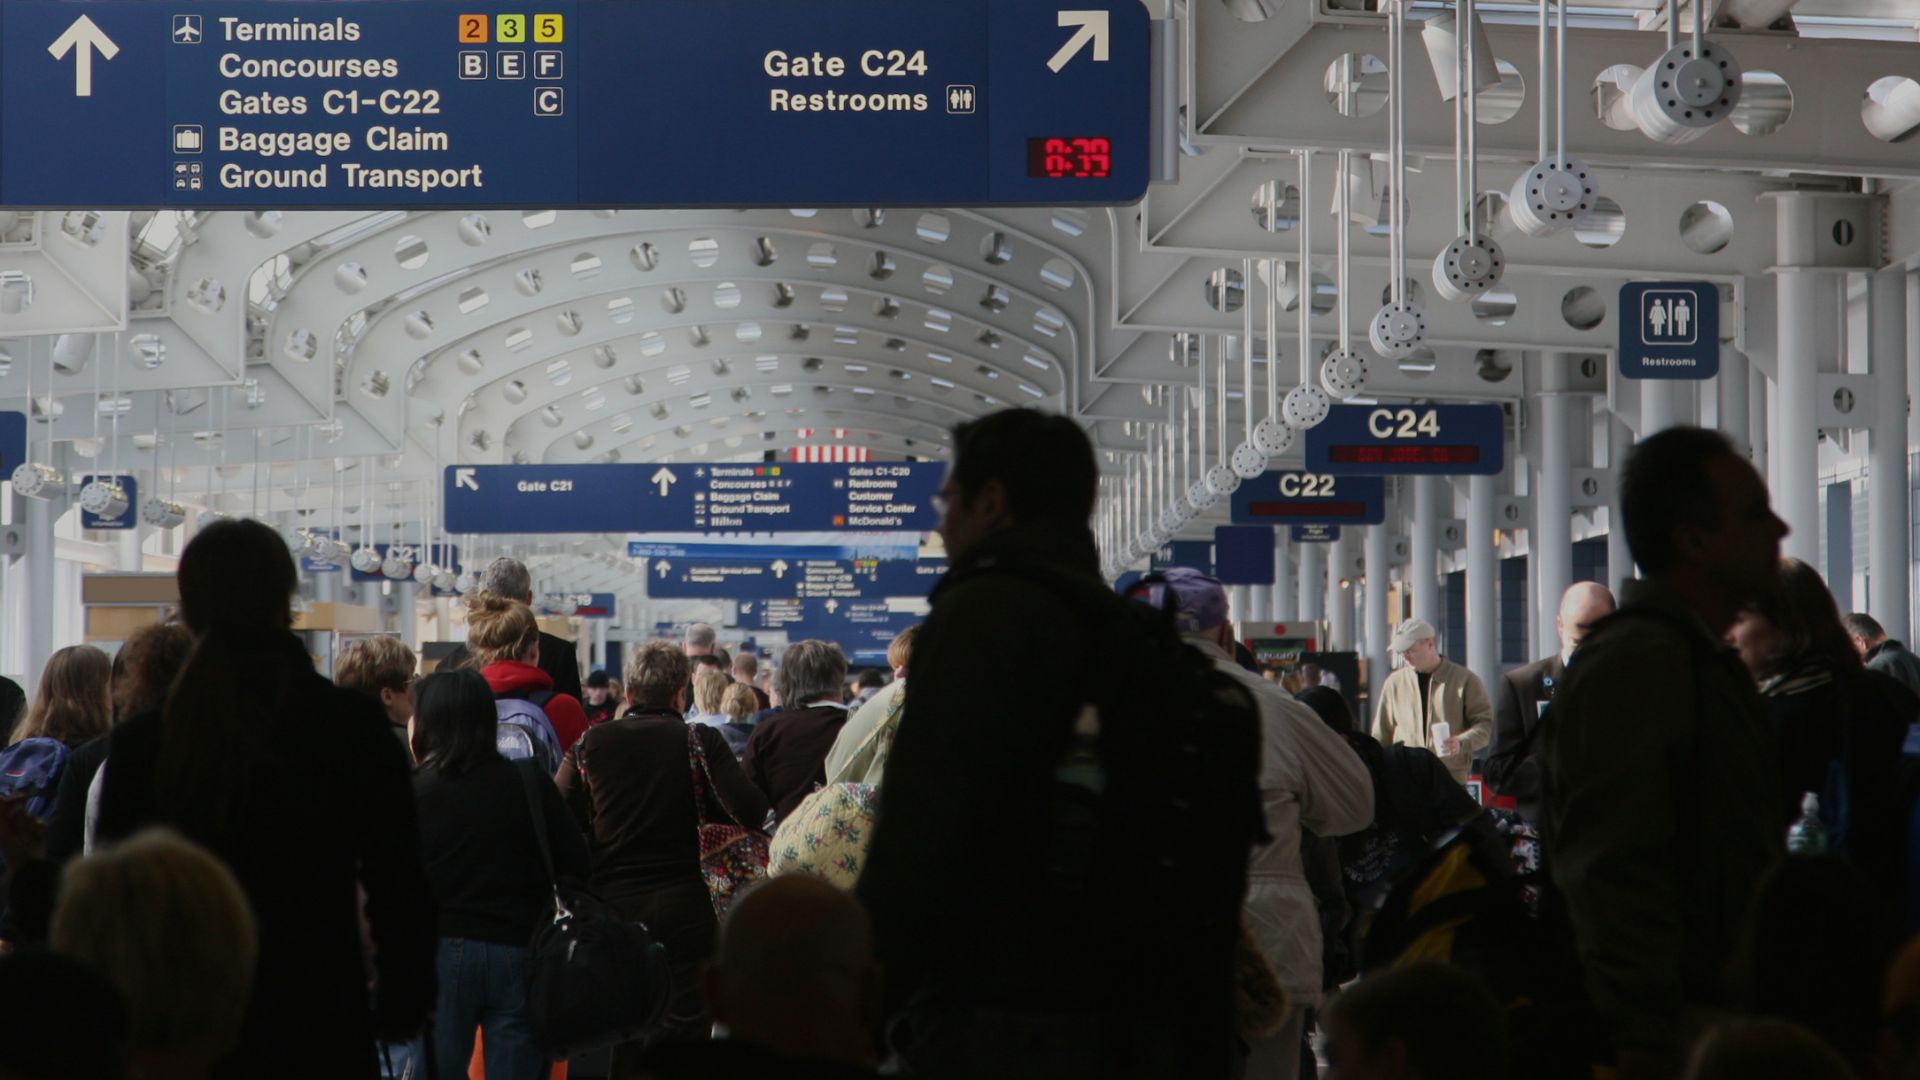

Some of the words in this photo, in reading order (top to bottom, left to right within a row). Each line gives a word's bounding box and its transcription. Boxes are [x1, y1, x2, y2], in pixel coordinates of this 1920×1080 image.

[219, 17, 360, 41] Terminals
[467, 19, 480, 37] 2
[504, 19, 517, 37] 3
[542, 19, 555, 37] 5
[220, 53, 398, 78] Concourses
[465, 55, 481, 75] B
[504, 55, 518, 75] E
[541, 55, 555, 74] F
[764, 51, 844, 77] Gate
[861, 50, 927, 76] C24
[220, 90, 307, 114] Gates
[323, 90, 439, 114] C1-C22
[540, 91, 557, 112] C
[771, 89, 927, 111] Restrooms
[220, 127, 350, 156] Baggage
[367, 126, 447, 151] Claim
[220, 164, 326, 188] Ground
[342, 164, 482, 192] Transport
[1642, 356, 1697, 367] Restrooms
[1368, 409, 1440, 438] C24
[710, 467, 755, 477] Terminals
[849, 467, 874, 477] Gates
[517, 480, 546, 492] Gate
[550, 480, 573, 492] C21
[710, 480, 767, 489] Concourses
[848, 479, 898, 489] Restrooms
[1280, 474, 1335, 496] C22
[710, 492, 752, 503] Baggage
[753, 492, 780, 501] Claim
[849, 491, 894, 501] Customer
[710, 504, 745, 514] Ground
[746, 504, 791, 515] Transport
[849, 504, 883, 514] Service
[885, 504, 917, 514] Center
[848, 516, 903, 526] McDonald's
